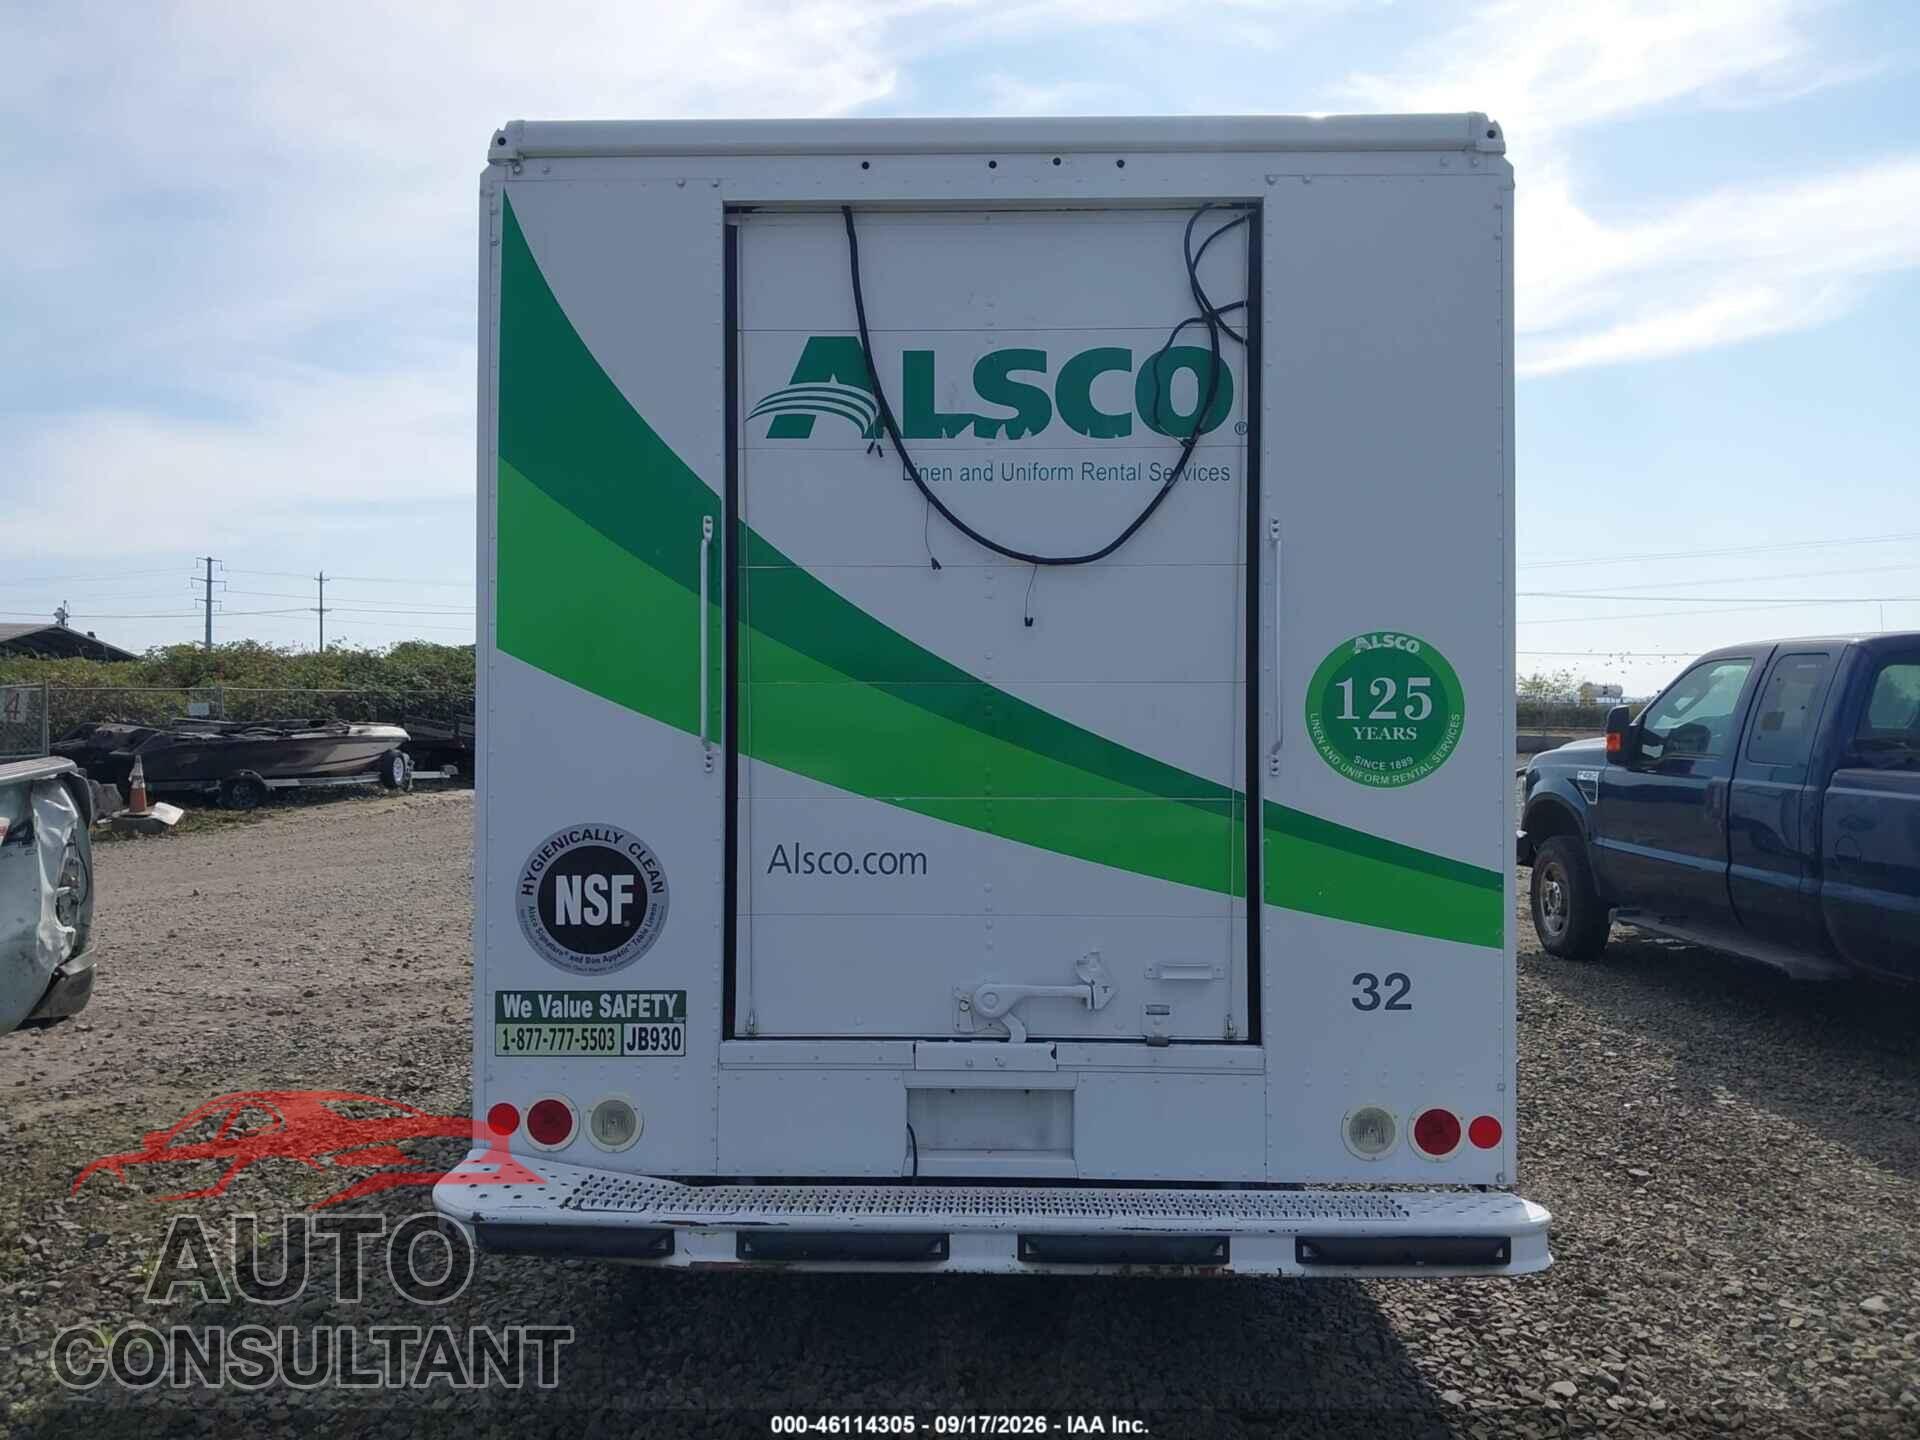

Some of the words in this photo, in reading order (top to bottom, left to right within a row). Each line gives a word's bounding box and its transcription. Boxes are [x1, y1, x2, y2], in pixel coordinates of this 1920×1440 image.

[744, 336, 1234, 440] ALSCO
[959, 464, 993, 481] and
[1001, 463, 1074, 482] Uniform
[1081, 463, 1141, 481] Rental
[1352, 634, 1420, 654] ALSCO
[1335, 676, 1433, 721] 125
[1310, 713, 1326, 745] LINEN
[1322, 744, 1341, 766] AND
[1340, 762, 1390, 785] UNIFORM
[1392, 762, 1434, 784] RENTAL
[1431, 713, 1460, 763] SERVICES
[1352, 726, 1417, 741] YEARS
[1353, 755, 1387, 771] SINCE
[521, 828, 625, 896] HYGIENICALLY
[628, 842, 665, 894] CLEAN
[767, 842, 927, 875] Alsco.com
[555, 874, 635, 926] NSF
[503, 994, 533, 1018] We
[538, 994, 593, 1018] Value
[599, 993, 678, 1018] SAFETY
[1351, 972, 1412, 1011] 32
[502, 1027, 616, 1051] 1-877-777-5503
[626, 1026, 682, 1051] JB930
